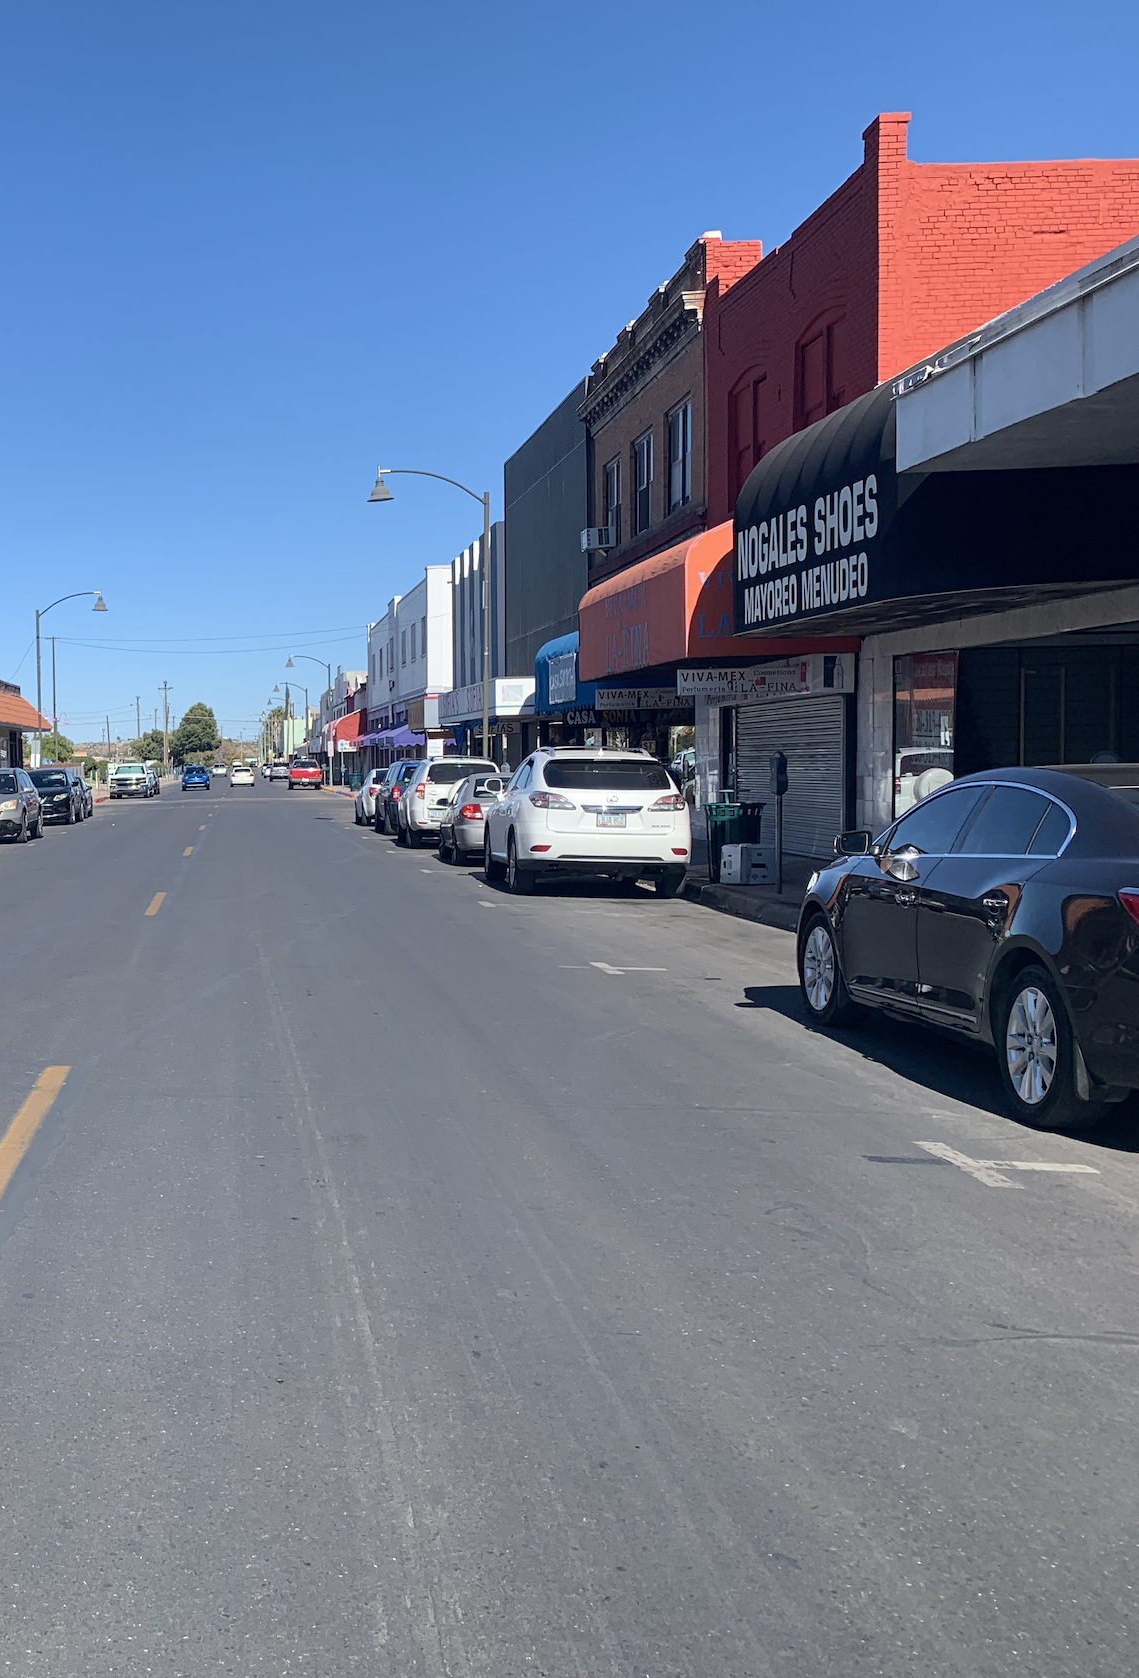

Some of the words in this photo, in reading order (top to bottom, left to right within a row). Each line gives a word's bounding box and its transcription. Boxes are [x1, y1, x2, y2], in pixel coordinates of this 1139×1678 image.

[737, 504, 808, 581] NOGALES
[814, 473, 879, 556] SHOES
[744, 573, 798, 625] MAYOREO
[801, 551, 869, 611] MENUDEO
[681, 671, 746, 683] VIVA-MEX
[598, 690, 650, 700] VIVA-MEX
[566, 710, 596, 725] CASA
